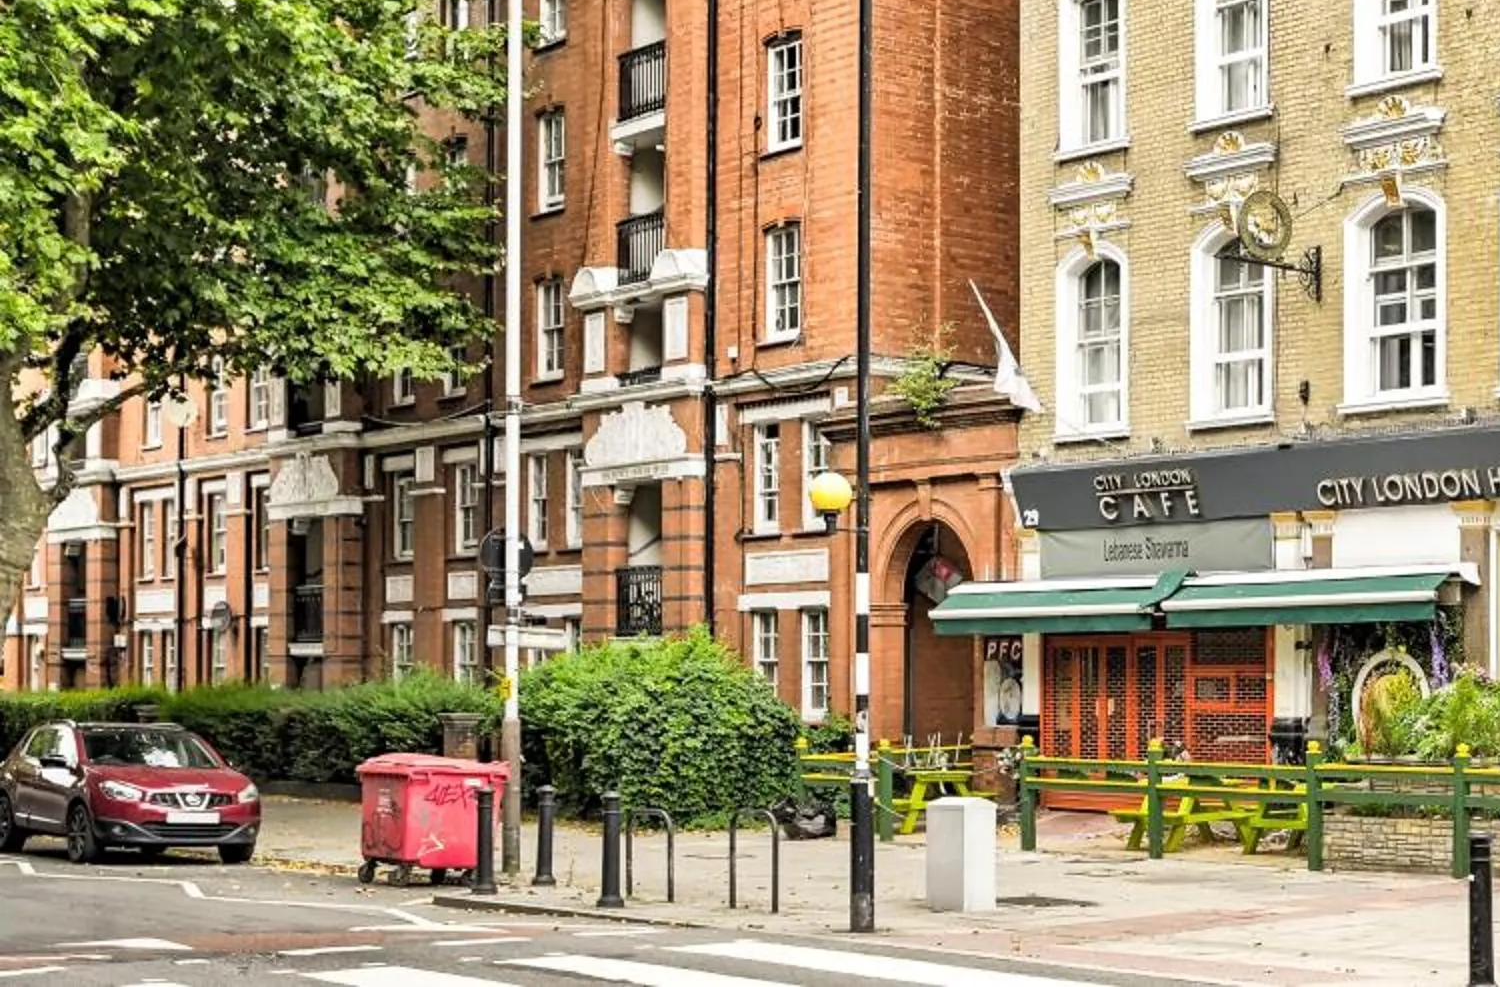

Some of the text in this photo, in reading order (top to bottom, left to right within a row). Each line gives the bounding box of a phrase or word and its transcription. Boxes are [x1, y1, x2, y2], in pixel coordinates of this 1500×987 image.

[1093, 468, 1192, 490] CITY LONDON
[1317, 477, 1363, 506] CITY
[1371, 468, 1481, 502] LONDON
[1023, 509, 1039, 525] 29
[1099, 490, 1200, 520] CAFE
[1103, 538, 1143, 562] Lebanese
